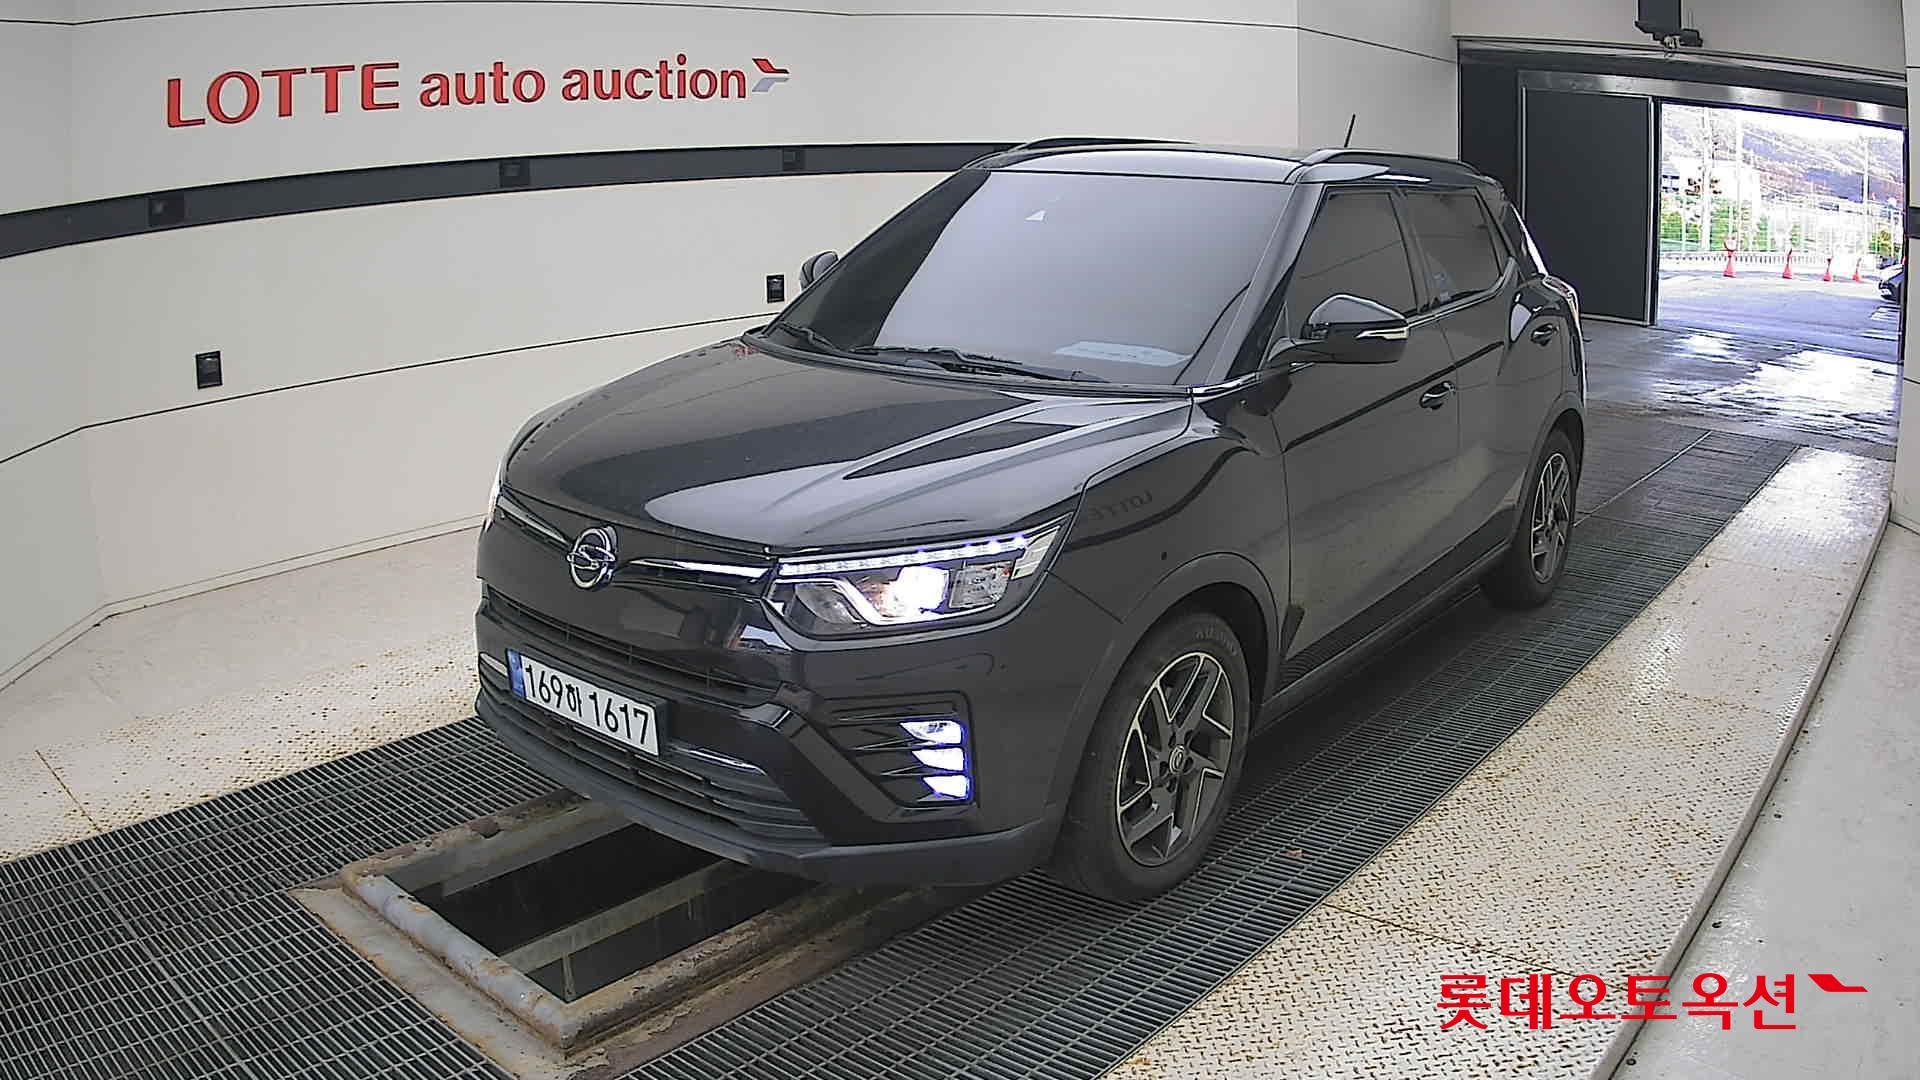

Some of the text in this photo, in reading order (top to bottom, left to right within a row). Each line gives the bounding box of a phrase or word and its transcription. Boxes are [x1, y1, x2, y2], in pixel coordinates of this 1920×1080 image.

[166, 53, 747, 128] LOTTE auto auction
[525, 664, 649, 745] 169하 1617
